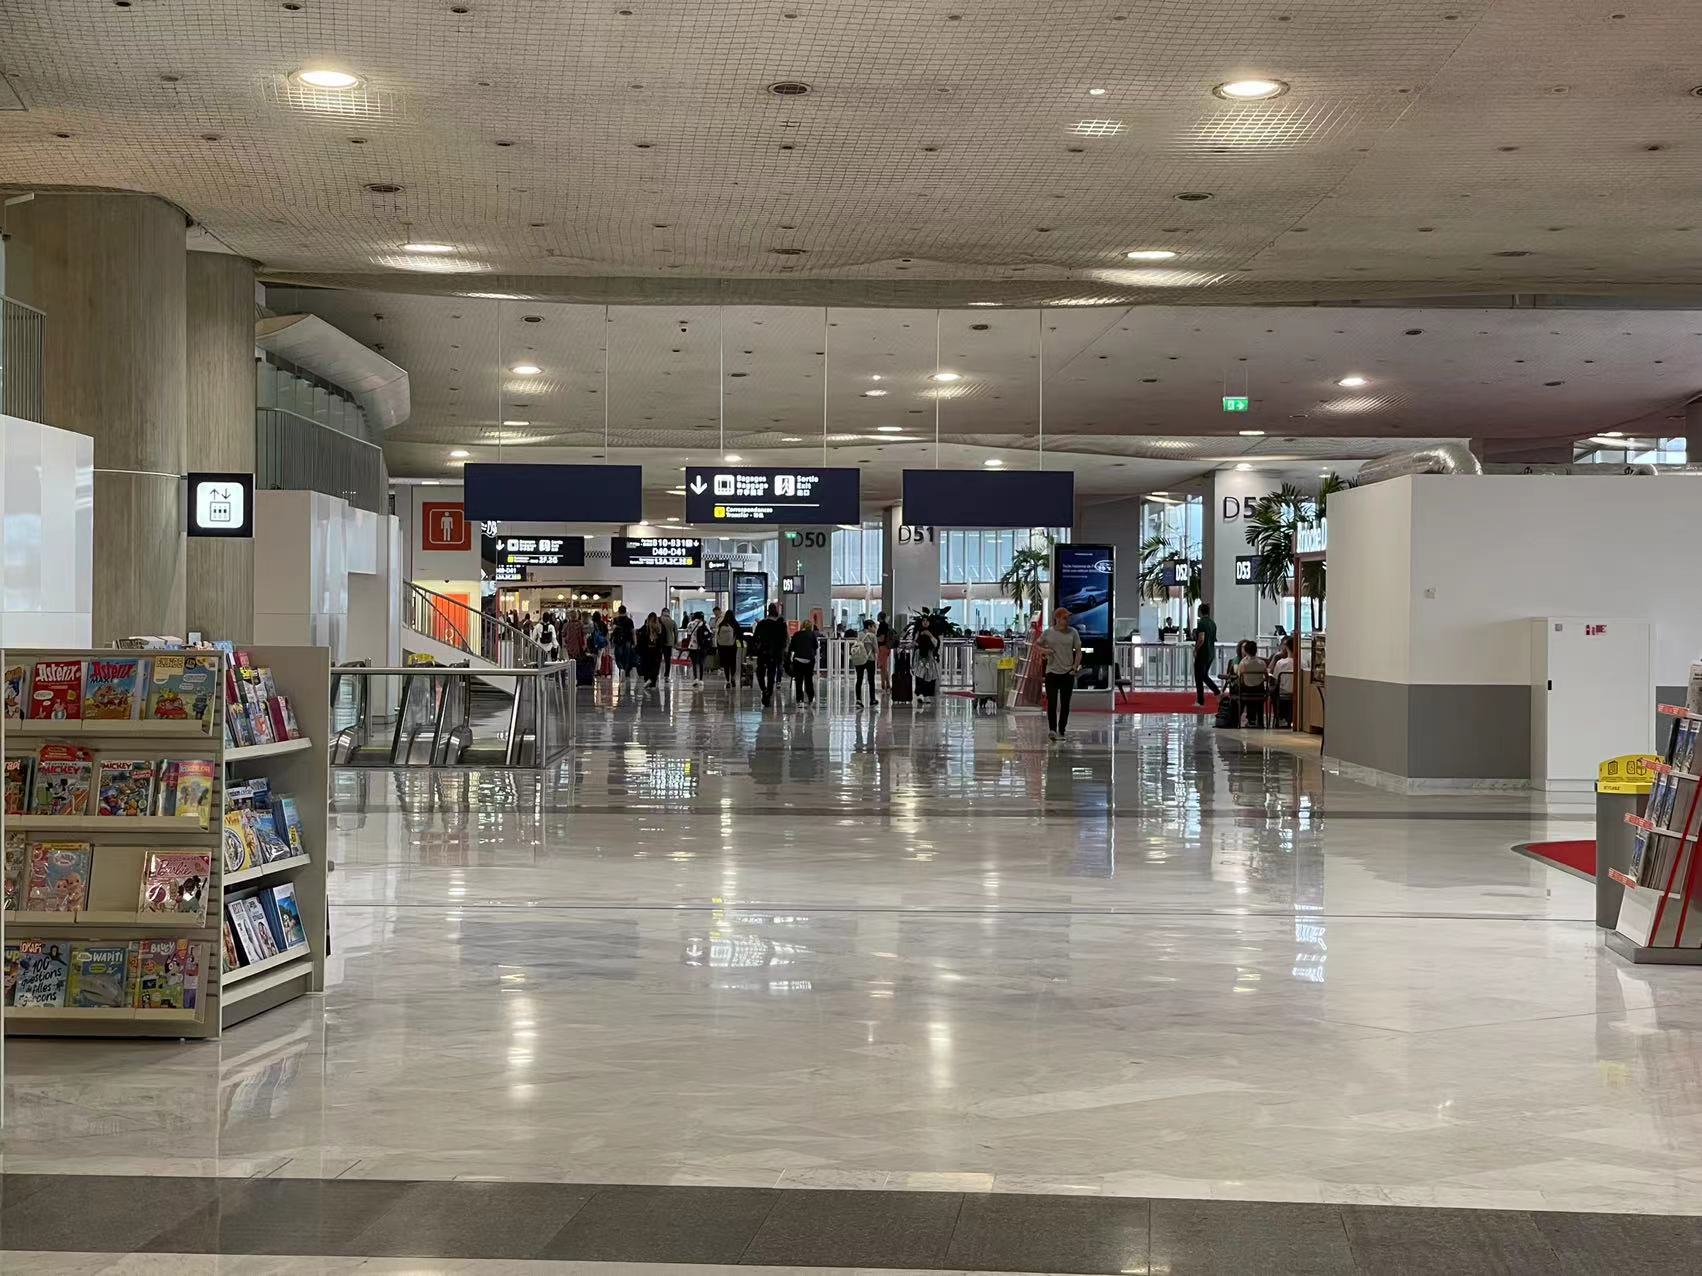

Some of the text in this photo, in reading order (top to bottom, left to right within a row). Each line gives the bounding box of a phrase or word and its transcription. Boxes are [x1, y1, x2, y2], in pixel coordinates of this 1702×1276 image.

[796, 475, 819, 483] Sortie
[796, 482, 812, 490] Exit
[791, 531, 826, 549] D50
[898, 525, 935, 544] D51
[1236, 561, 1251, 580] D53
[156, 860, 192, 876] Barbie
[32, 957, 50, 975] 100
[21, 968, 62, 990] questions
